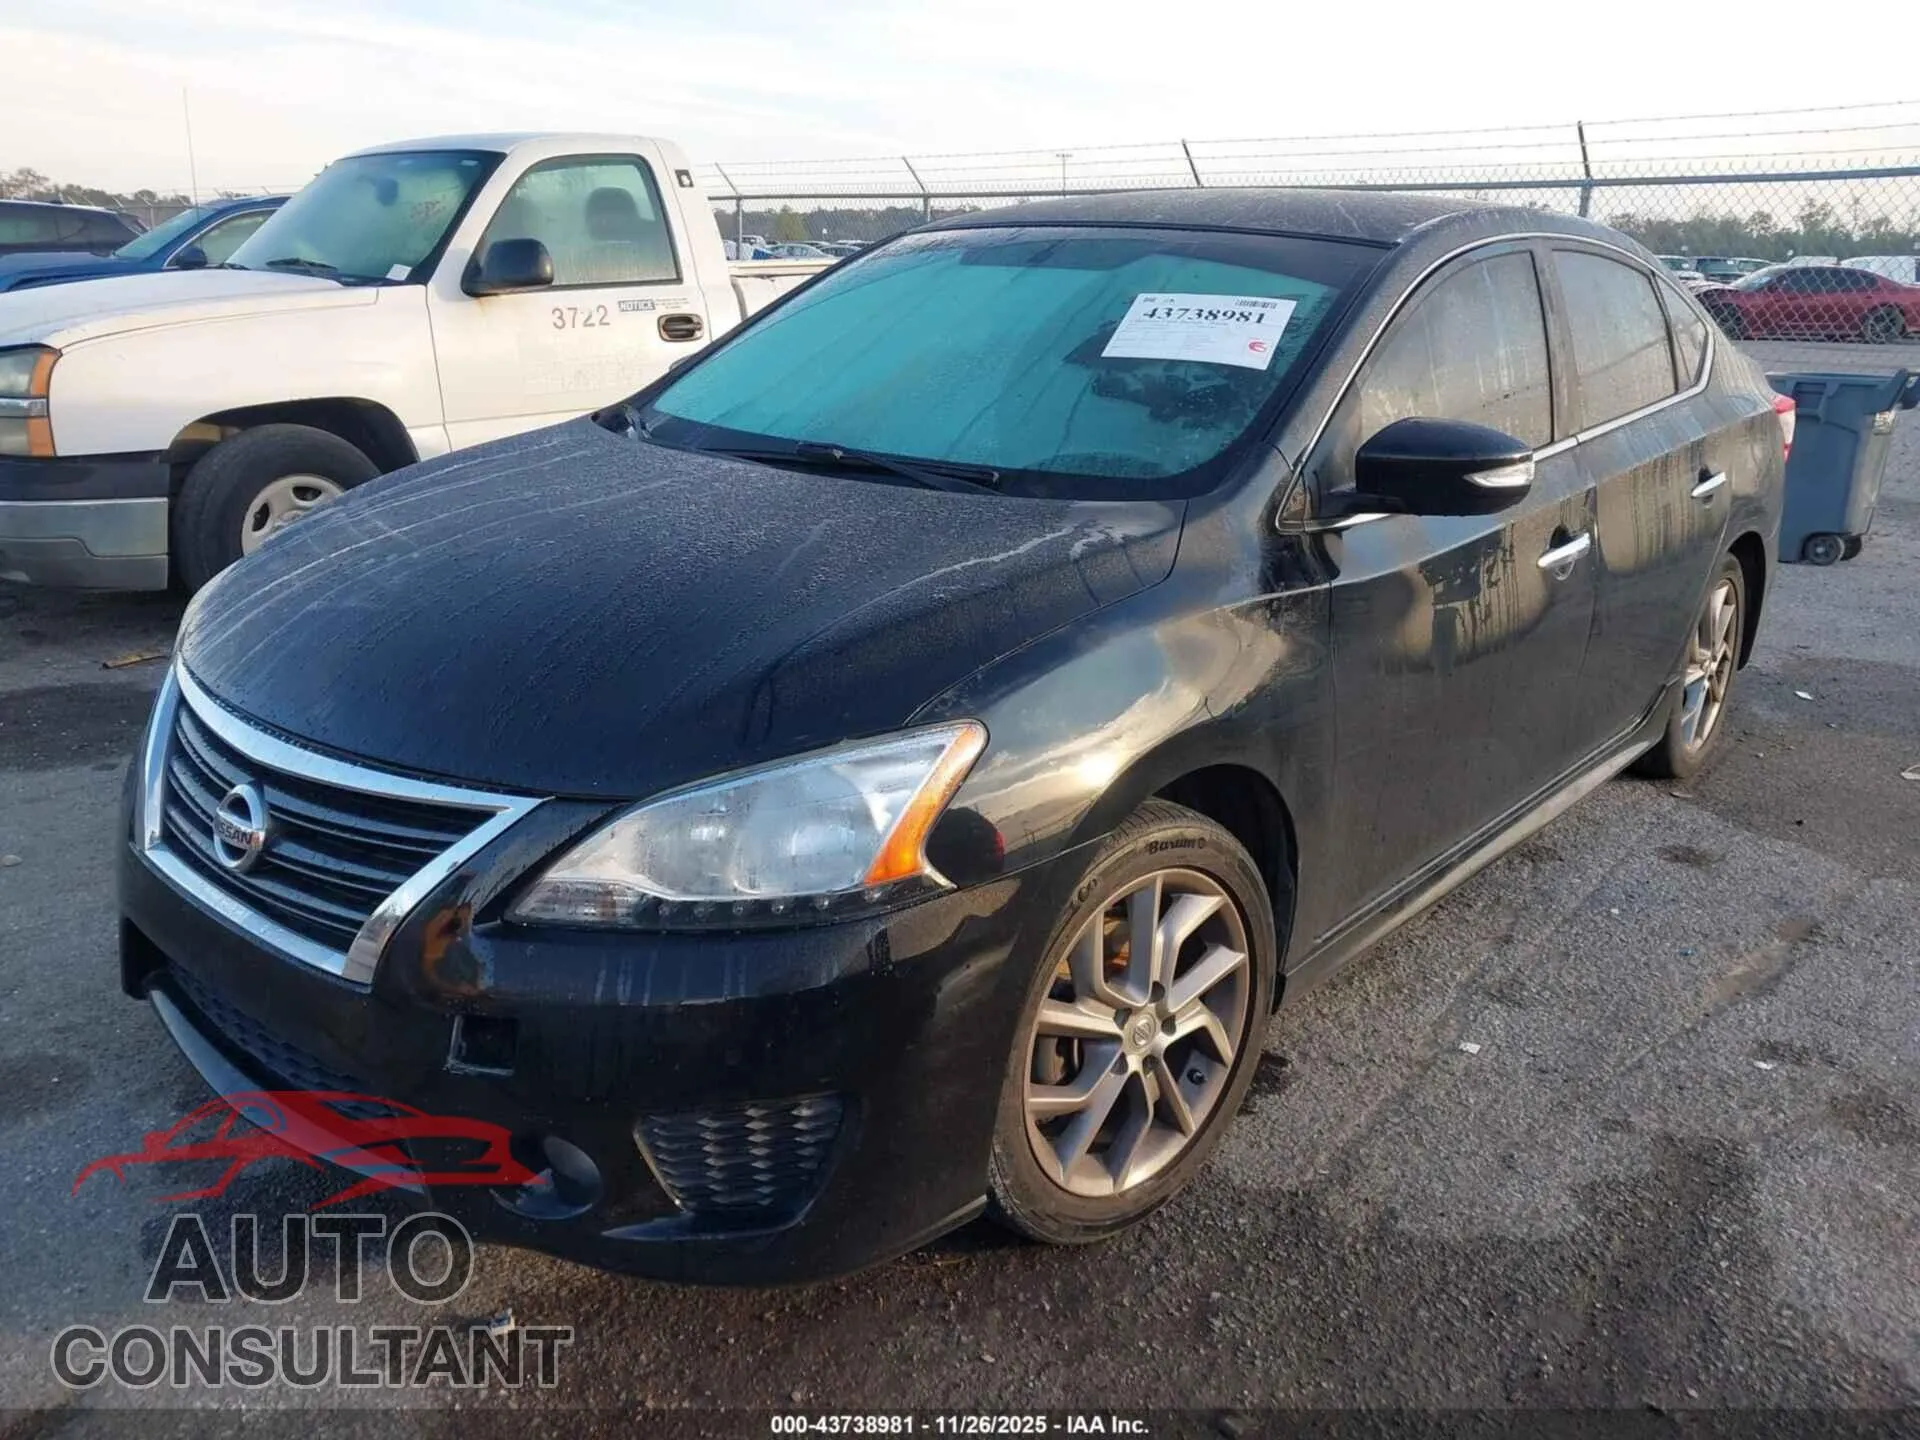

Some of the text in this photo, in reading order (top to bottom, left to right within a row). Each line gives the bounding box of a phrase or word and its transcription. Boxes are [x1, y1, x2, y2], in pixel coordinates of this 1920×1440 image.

[551, 304, 610, 329] 3722
[1143, 307, 1266, 324] 43738981
[215, 821, 252, 845] SSAN
